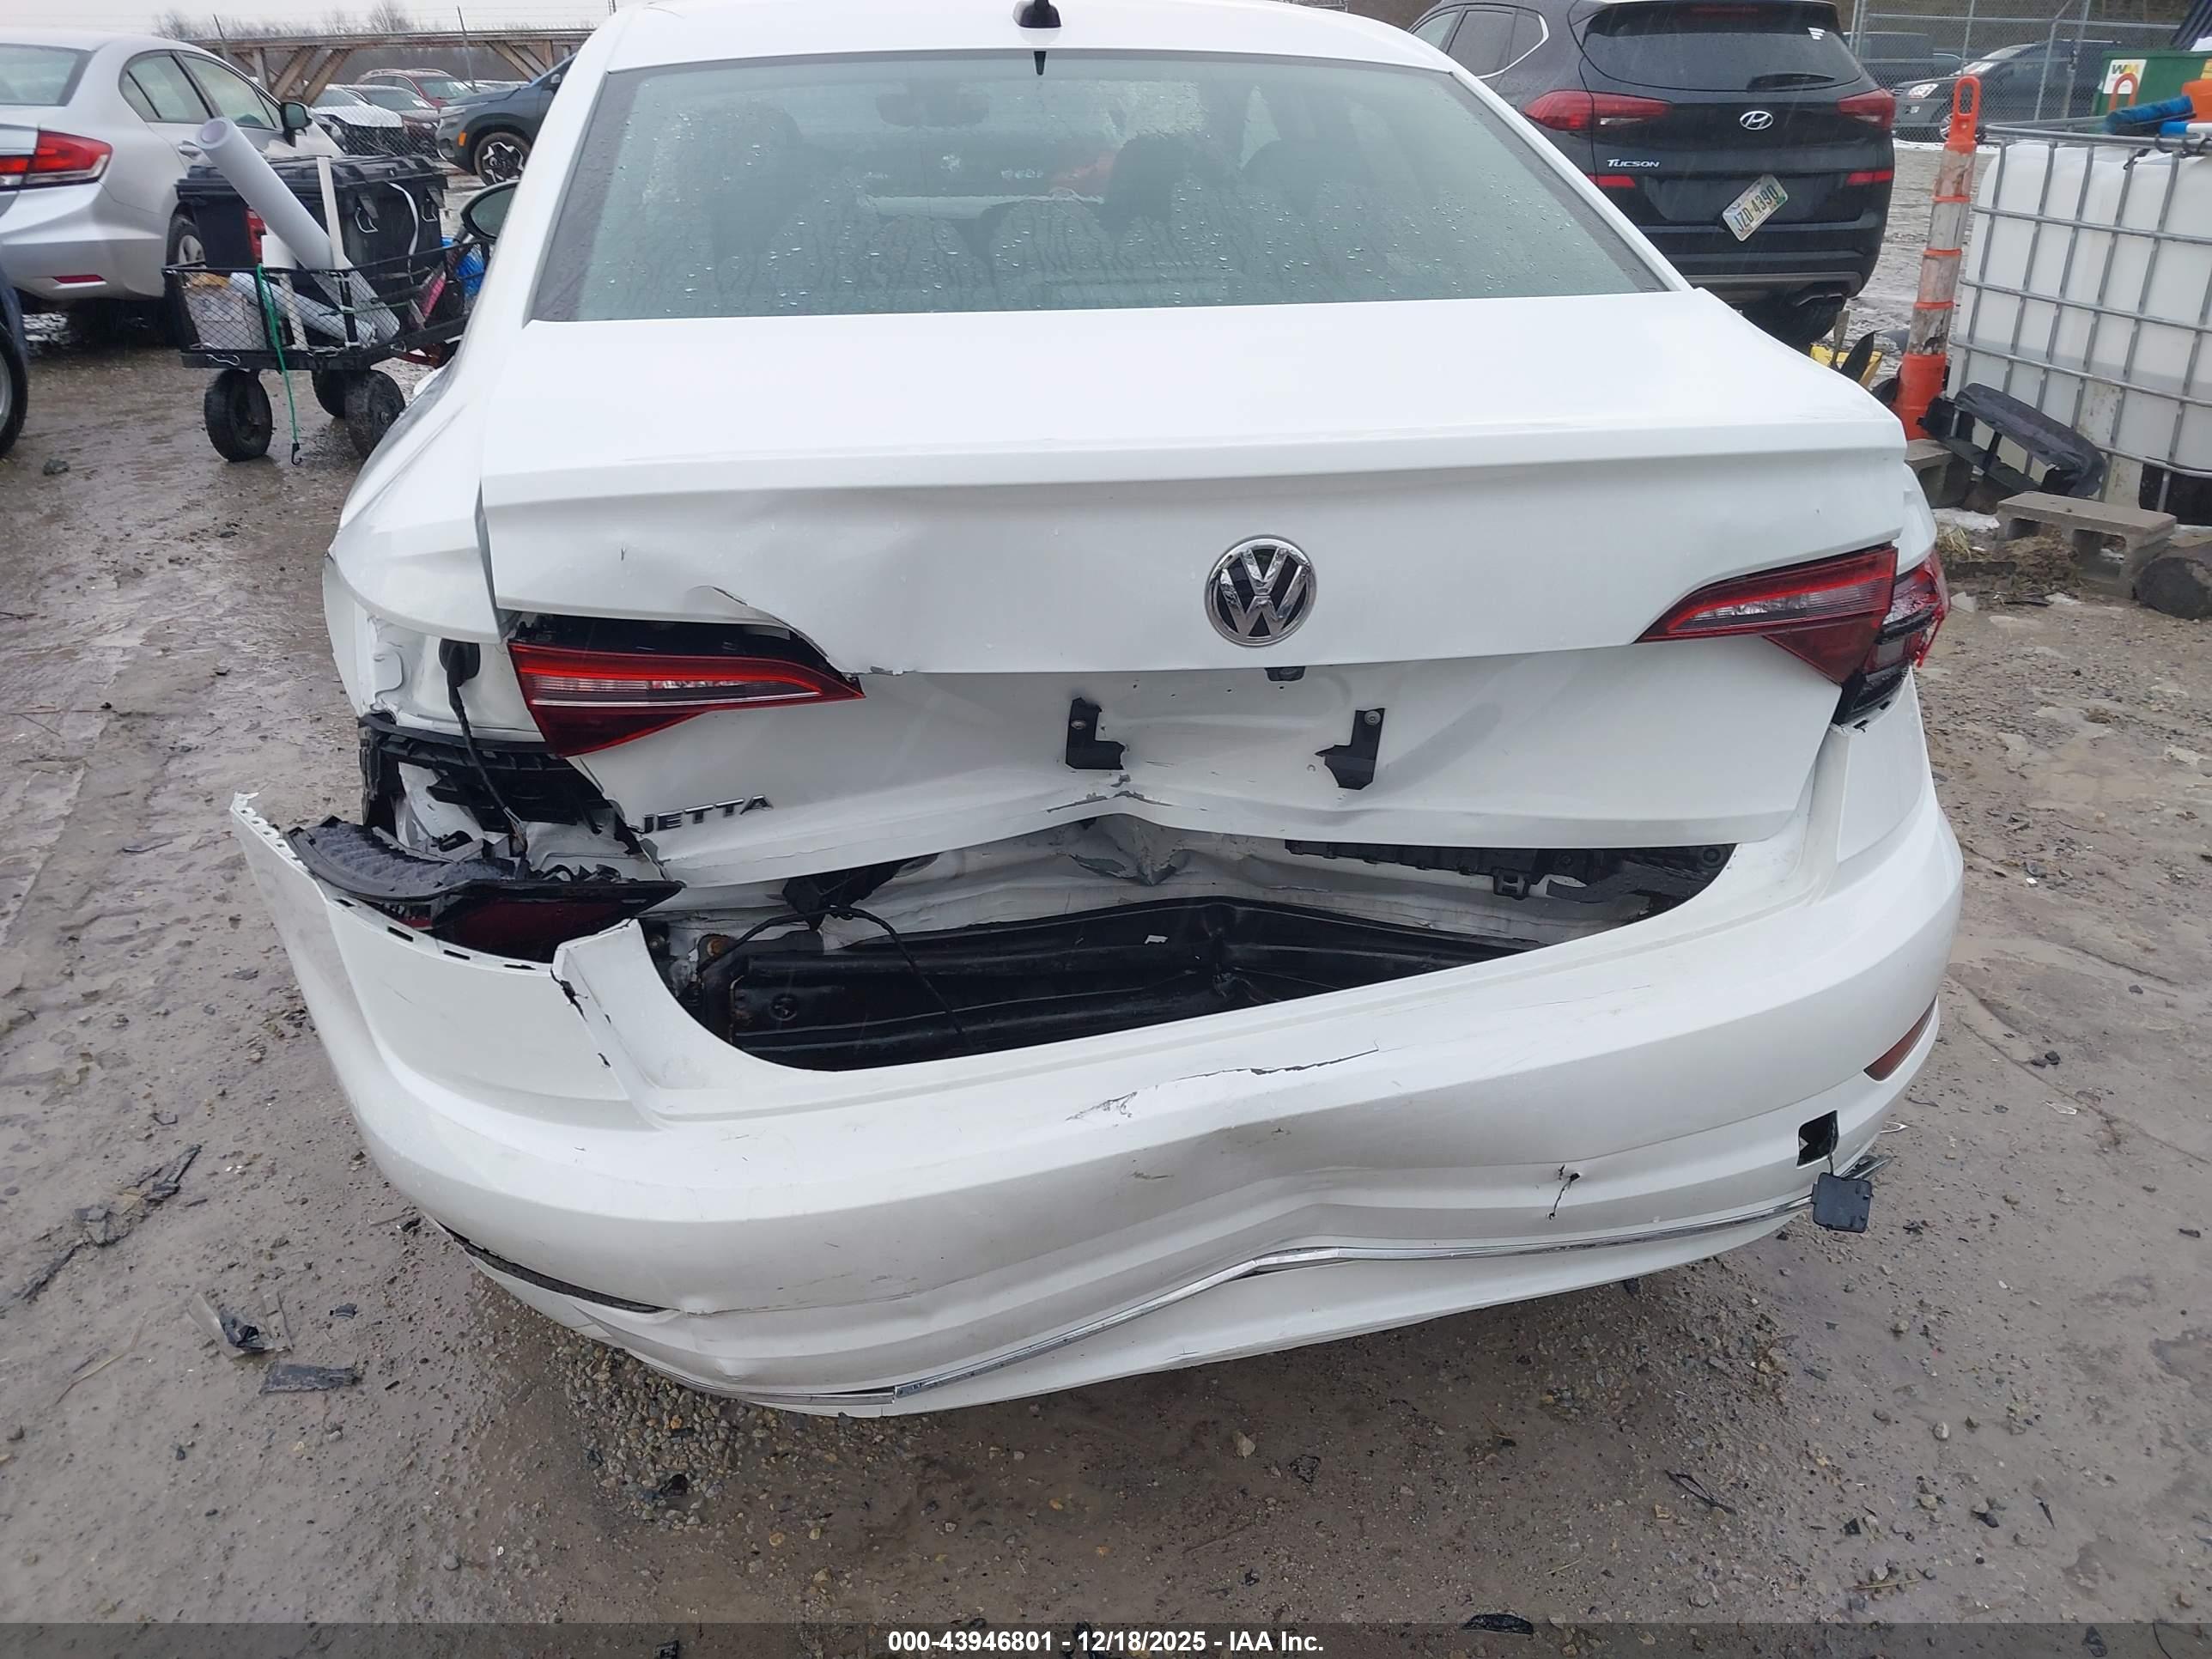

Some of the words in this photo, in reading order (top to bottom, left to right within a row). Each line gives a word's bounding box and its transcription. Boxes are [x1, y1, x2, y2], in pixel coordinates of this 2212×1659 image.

[1607, 158, 1661, 168] TUCSON
[1734, 207, 1754, 233] JZD
[1751, 185, 1779, 214] 4390
[1216, 544, 1310, 639] VW
[631, 794, 775, 834] JETTA
